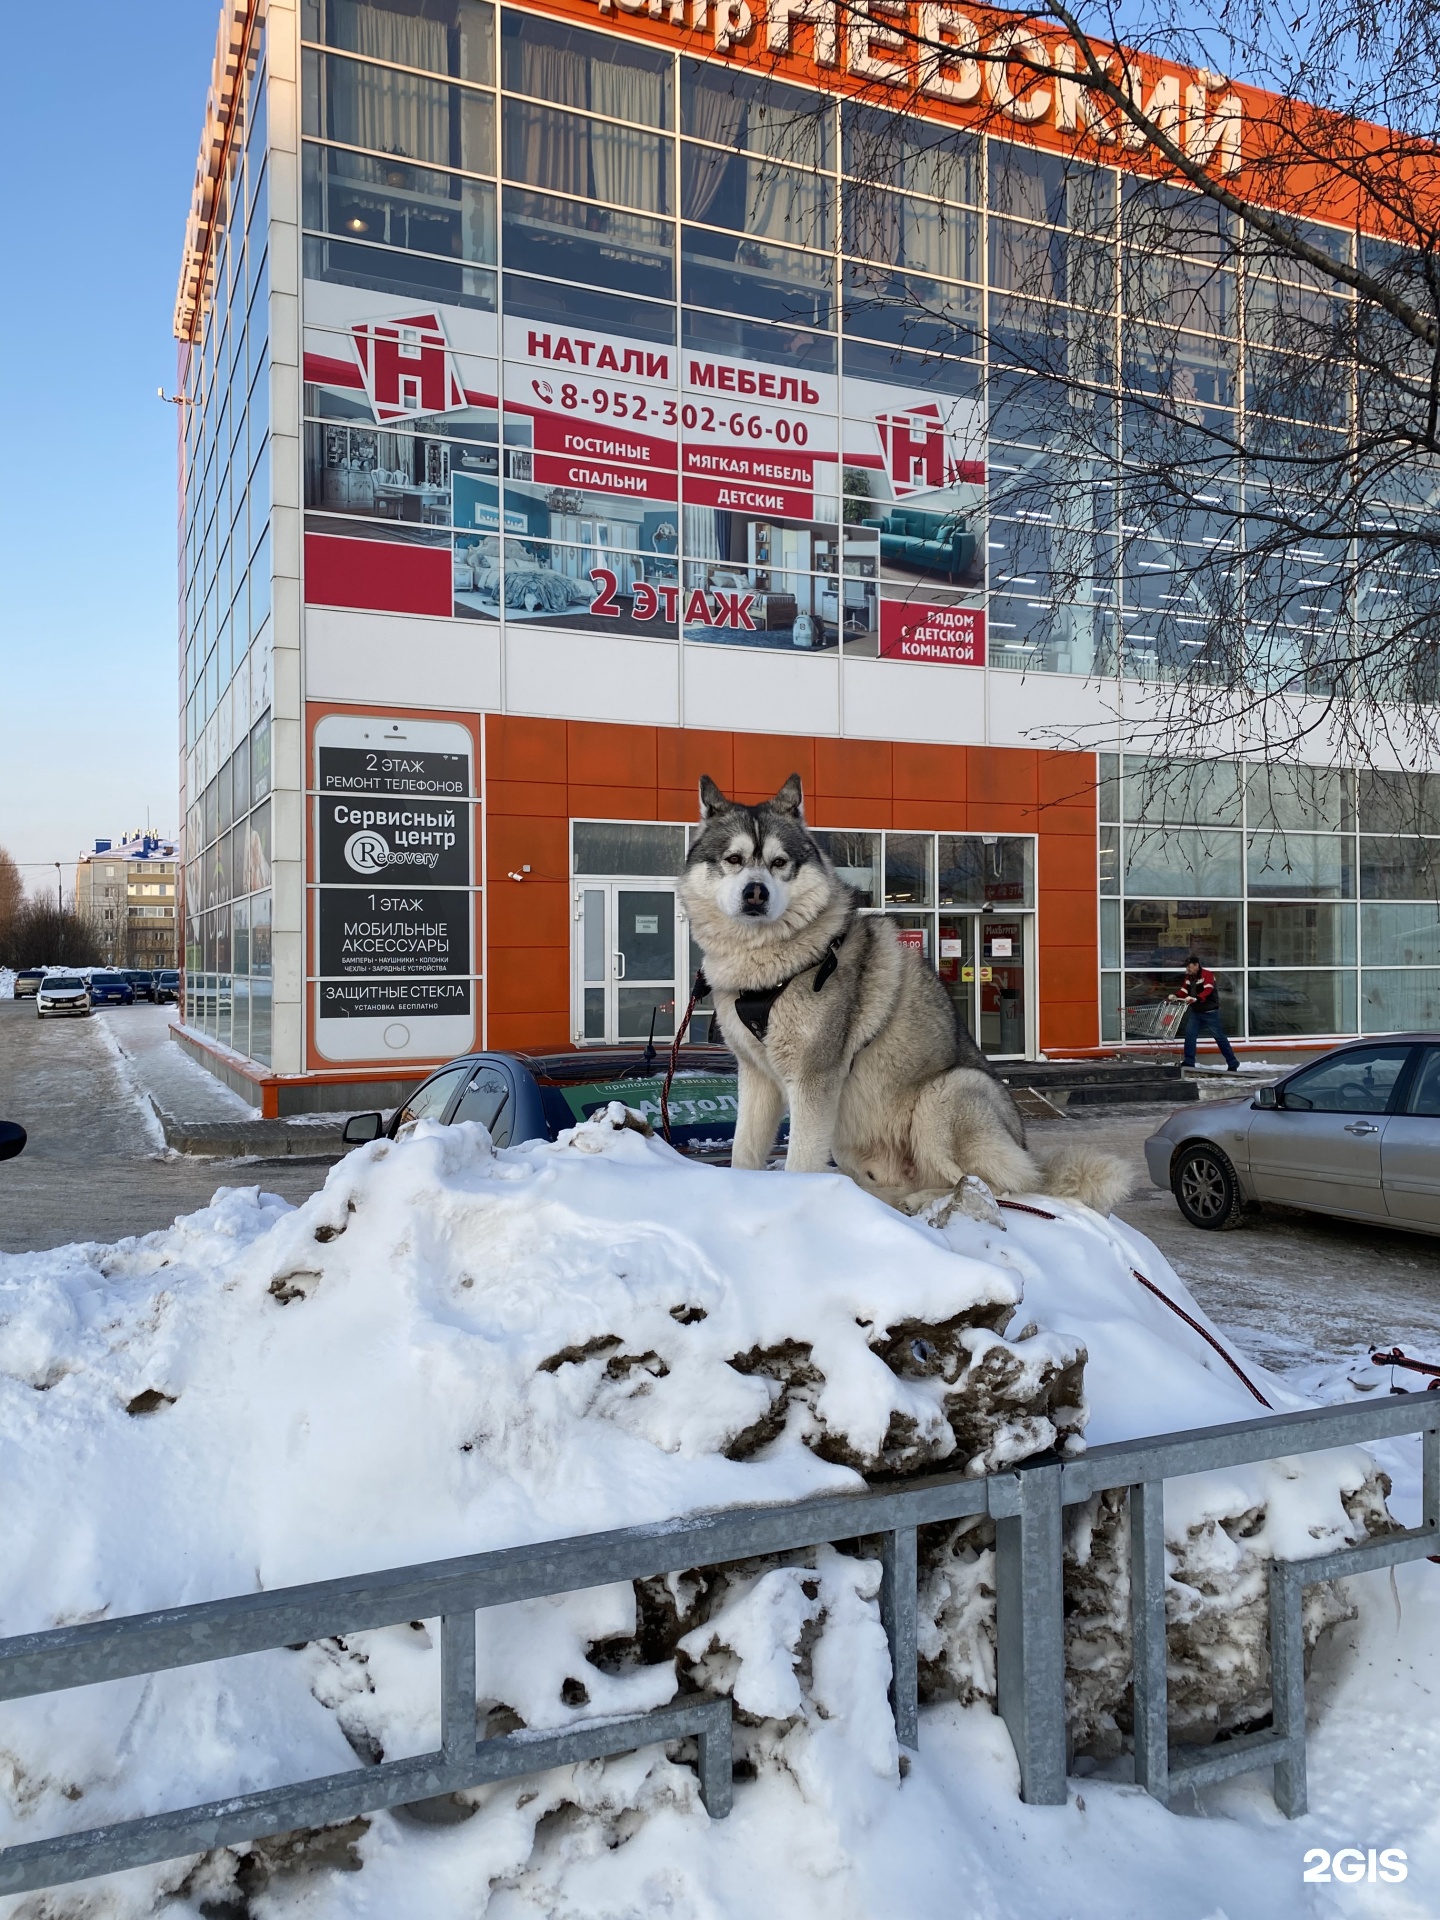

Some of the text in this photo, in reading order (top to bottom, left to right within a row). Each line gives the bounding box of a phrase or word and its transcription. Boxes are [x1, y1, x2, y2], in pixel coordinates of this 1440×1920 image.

[527, 330, 820, 405] НАТАЛИ МЕБЕЛЬ
[560, 383, 809, 446] 8-952-302-66-00
[564, 434, 651, 460] ГОСТИНЫЕ
[688, 452, 812, 483] МЯГКАЯ МЕБЕЛЬ
[568, 467, 648, 492] СПАЛЬНИ
[717, 488, 784, 510] ДЕТСКИЕ
[589, 568, 757, 631] 2 ЭТАЖ
[927, 611, 974, 628] РЯДОМ
[901, 625, 974, 644] С ДЕТСКОЙ
[902, 642, 974, 660] КОМНАТОЙ
[366, 753, 425, 774] 2 ЭТАЖ
[326, 775, 464, 793] РЕМОНТ ТЕЛЕФОНОВ
[334, 805, 456, 829] Сервисный
[395, 830, 456, 850] центр
[359, 841, 439, 869] Recovery
[367, 893, 424, 912] 1 ЭТАЖ
[344, 922, 448, 936] МОБИЛЬНЫЕ
[341, 938, 449, 953] АКСЕССУАРЫ
[407, 964, 447, 972] УСТРОЙСТВА
[326, 985, 465, 1000] ЗАЩИТНЫЕ СТЕКЛА
